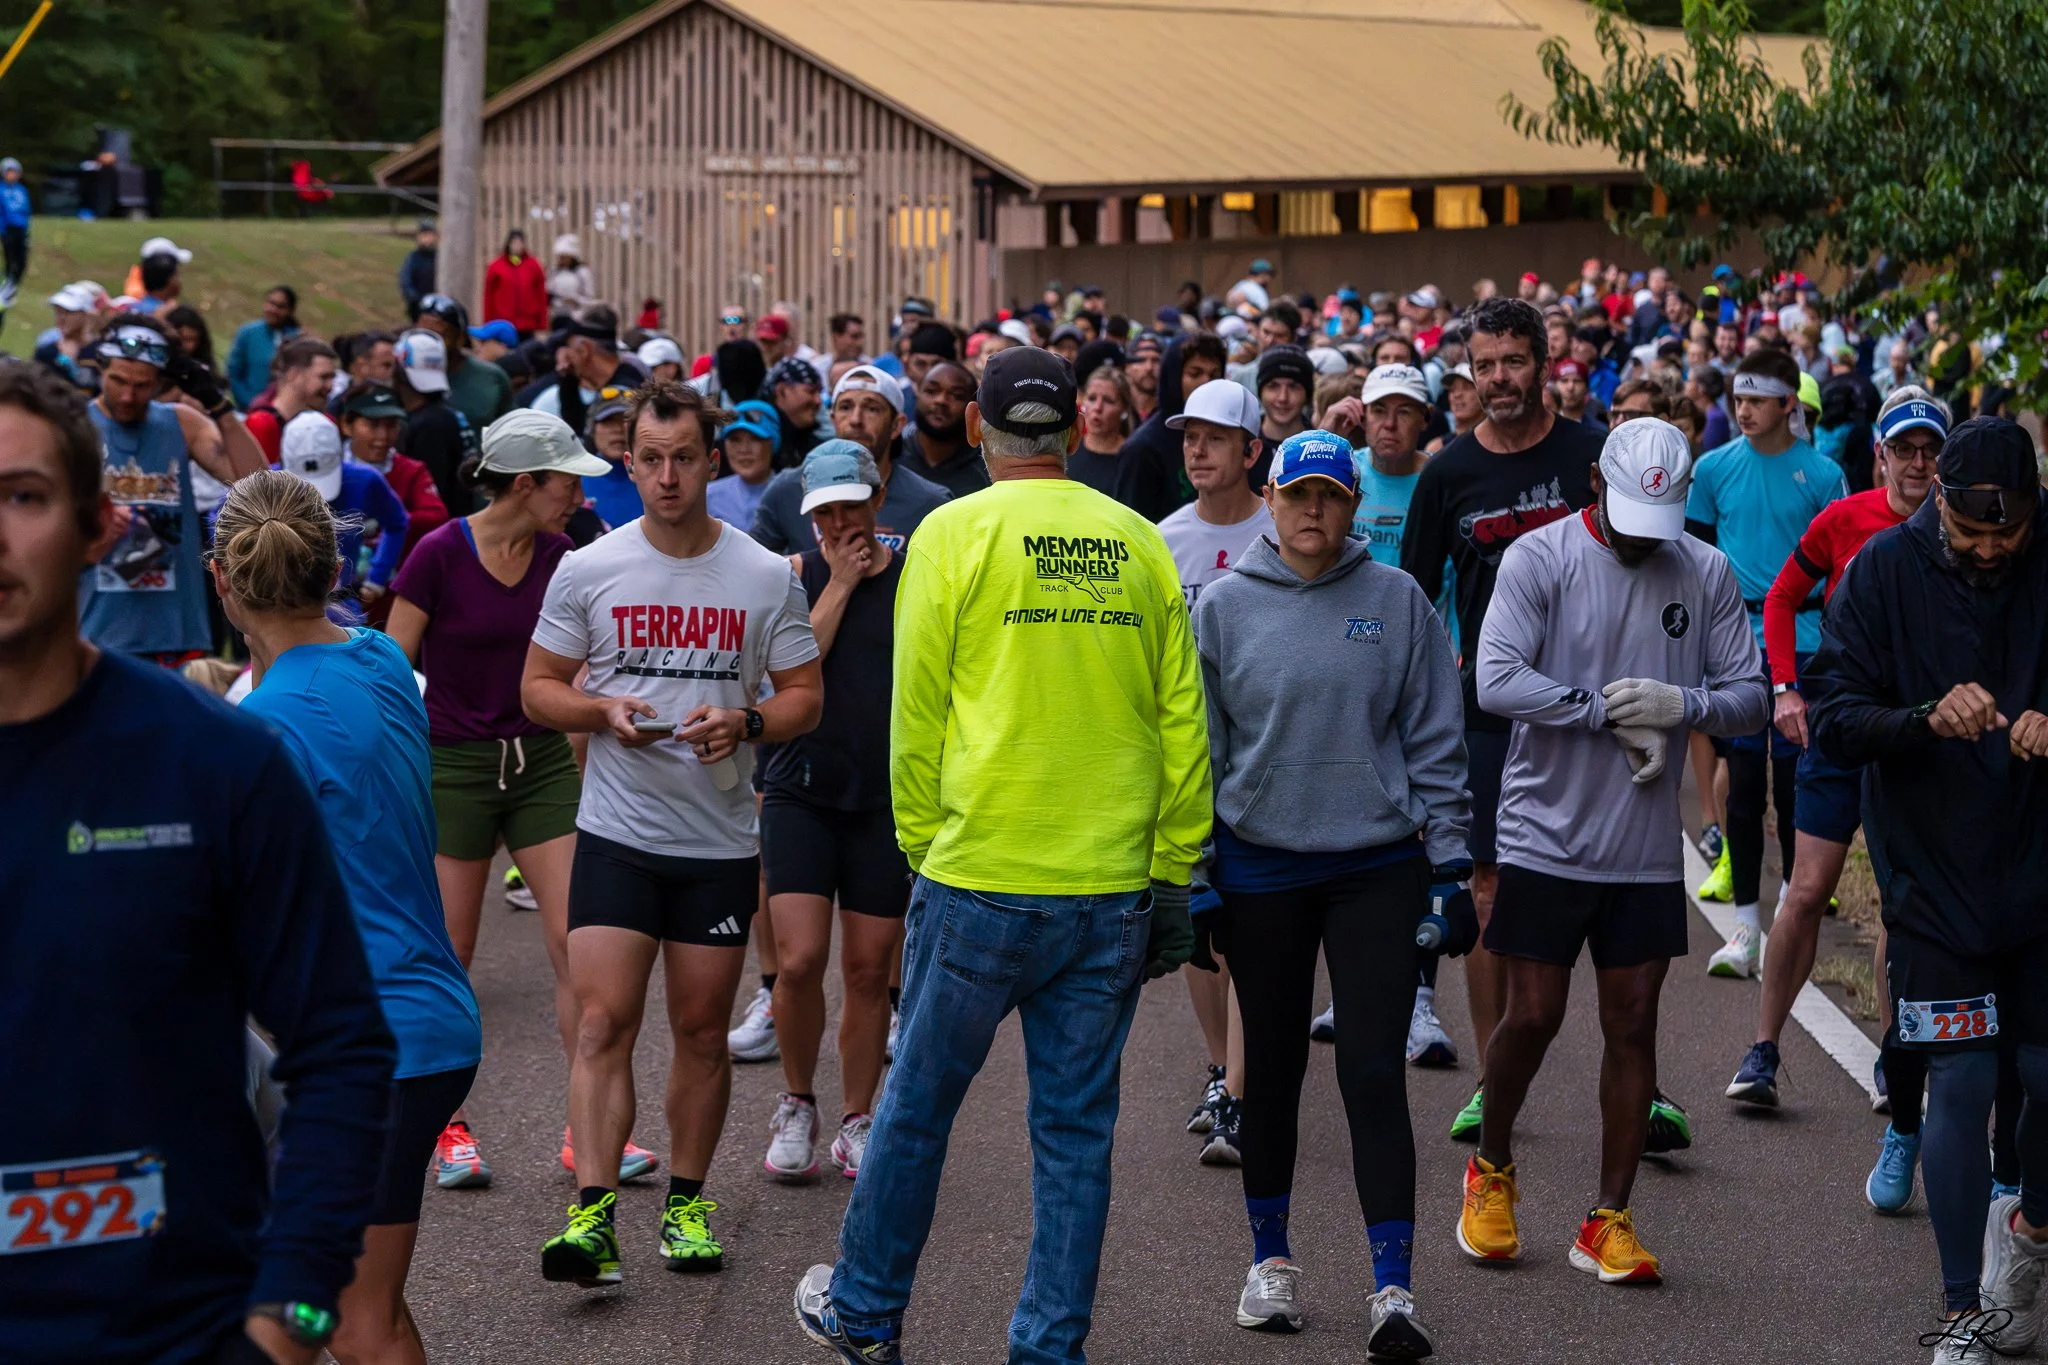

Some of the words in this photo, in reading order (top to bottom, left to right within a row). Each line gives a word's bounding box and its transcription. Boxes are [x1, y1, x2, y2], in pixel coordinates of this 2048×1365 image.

[1014, 378, 1031, 388] FINISH
[1044, 380, 1059, 391] CREW
[1023, 535, 1129, 562] MEMPHIS
[1036, 557, 1120, 576] RUNNERS
[1040, 584, 1069, 593] TRACK
[1101, 586, 1123, 595] CLUB
[611, 604, 747, 652] TERRAPIN
[1003, 608, 1058, 626] FINISH
[1061, 608, 1097, 624] LINE
[1100, 610, 1144, 628] CREW
[617, 649, 741, 670] RACING
[1933, 1010, 1987, 1039] 228
[8, 1184, 138, 1247] 292
